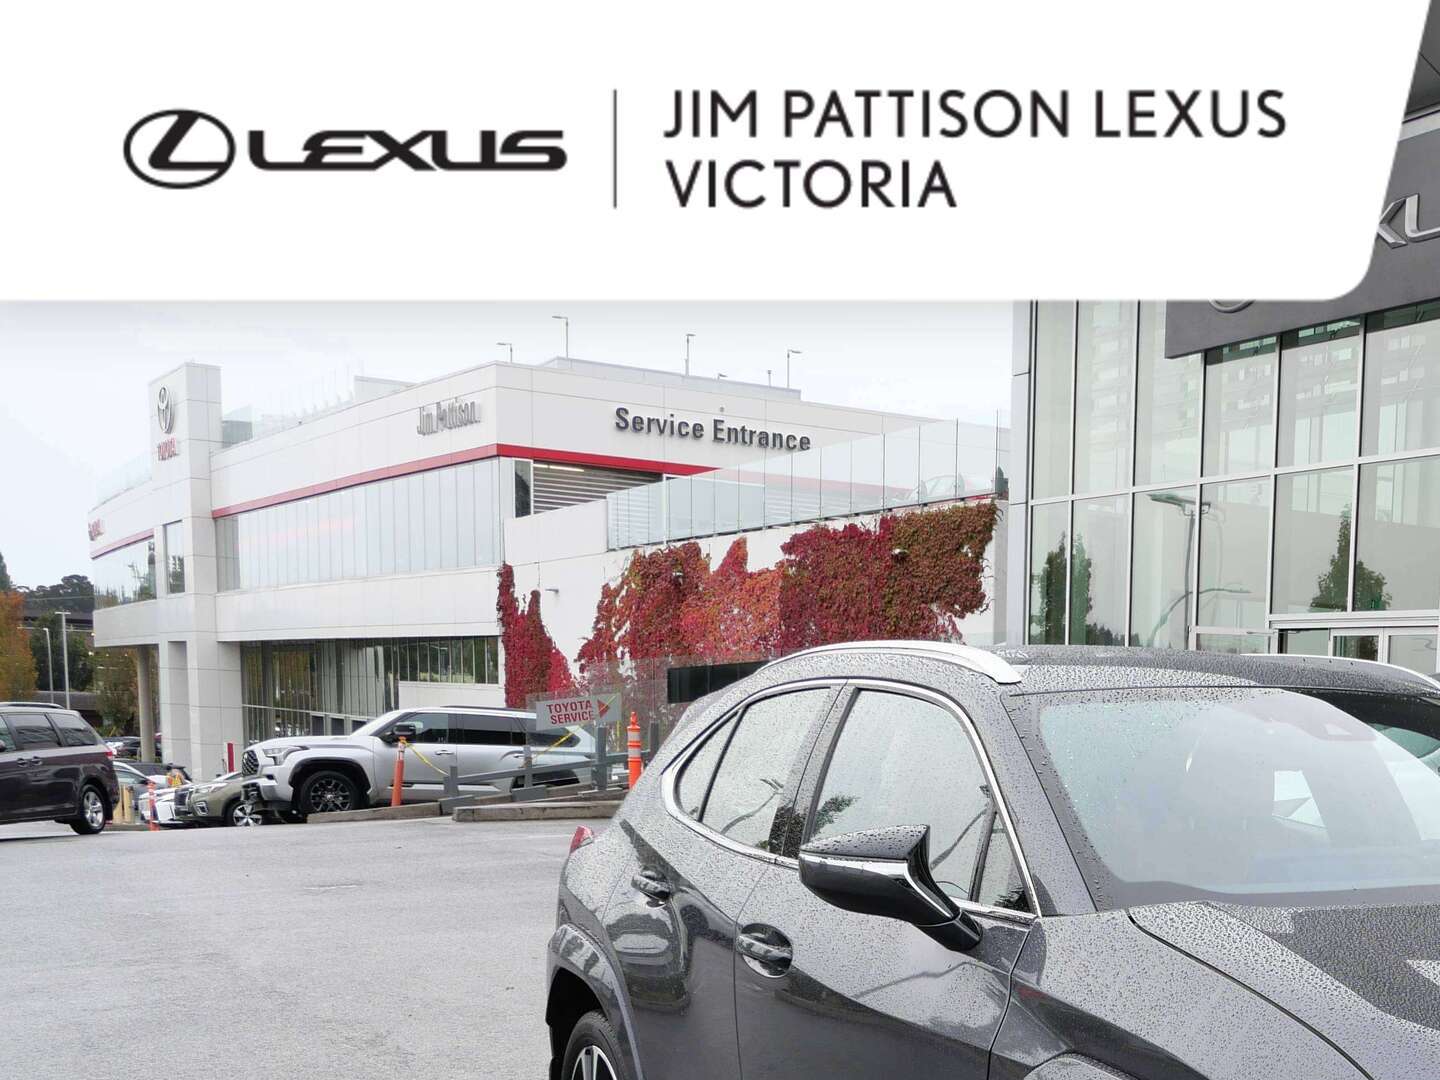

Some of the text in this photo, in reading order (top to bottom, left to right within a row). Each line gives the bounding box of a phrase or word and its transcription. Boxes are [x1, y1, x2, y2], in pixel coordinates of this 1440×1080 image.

[615, 406, 811, 451] Service Entrance
[546, 700, 592, 714] TOYOTA
[550, 711, 594, 724] SERVICE
